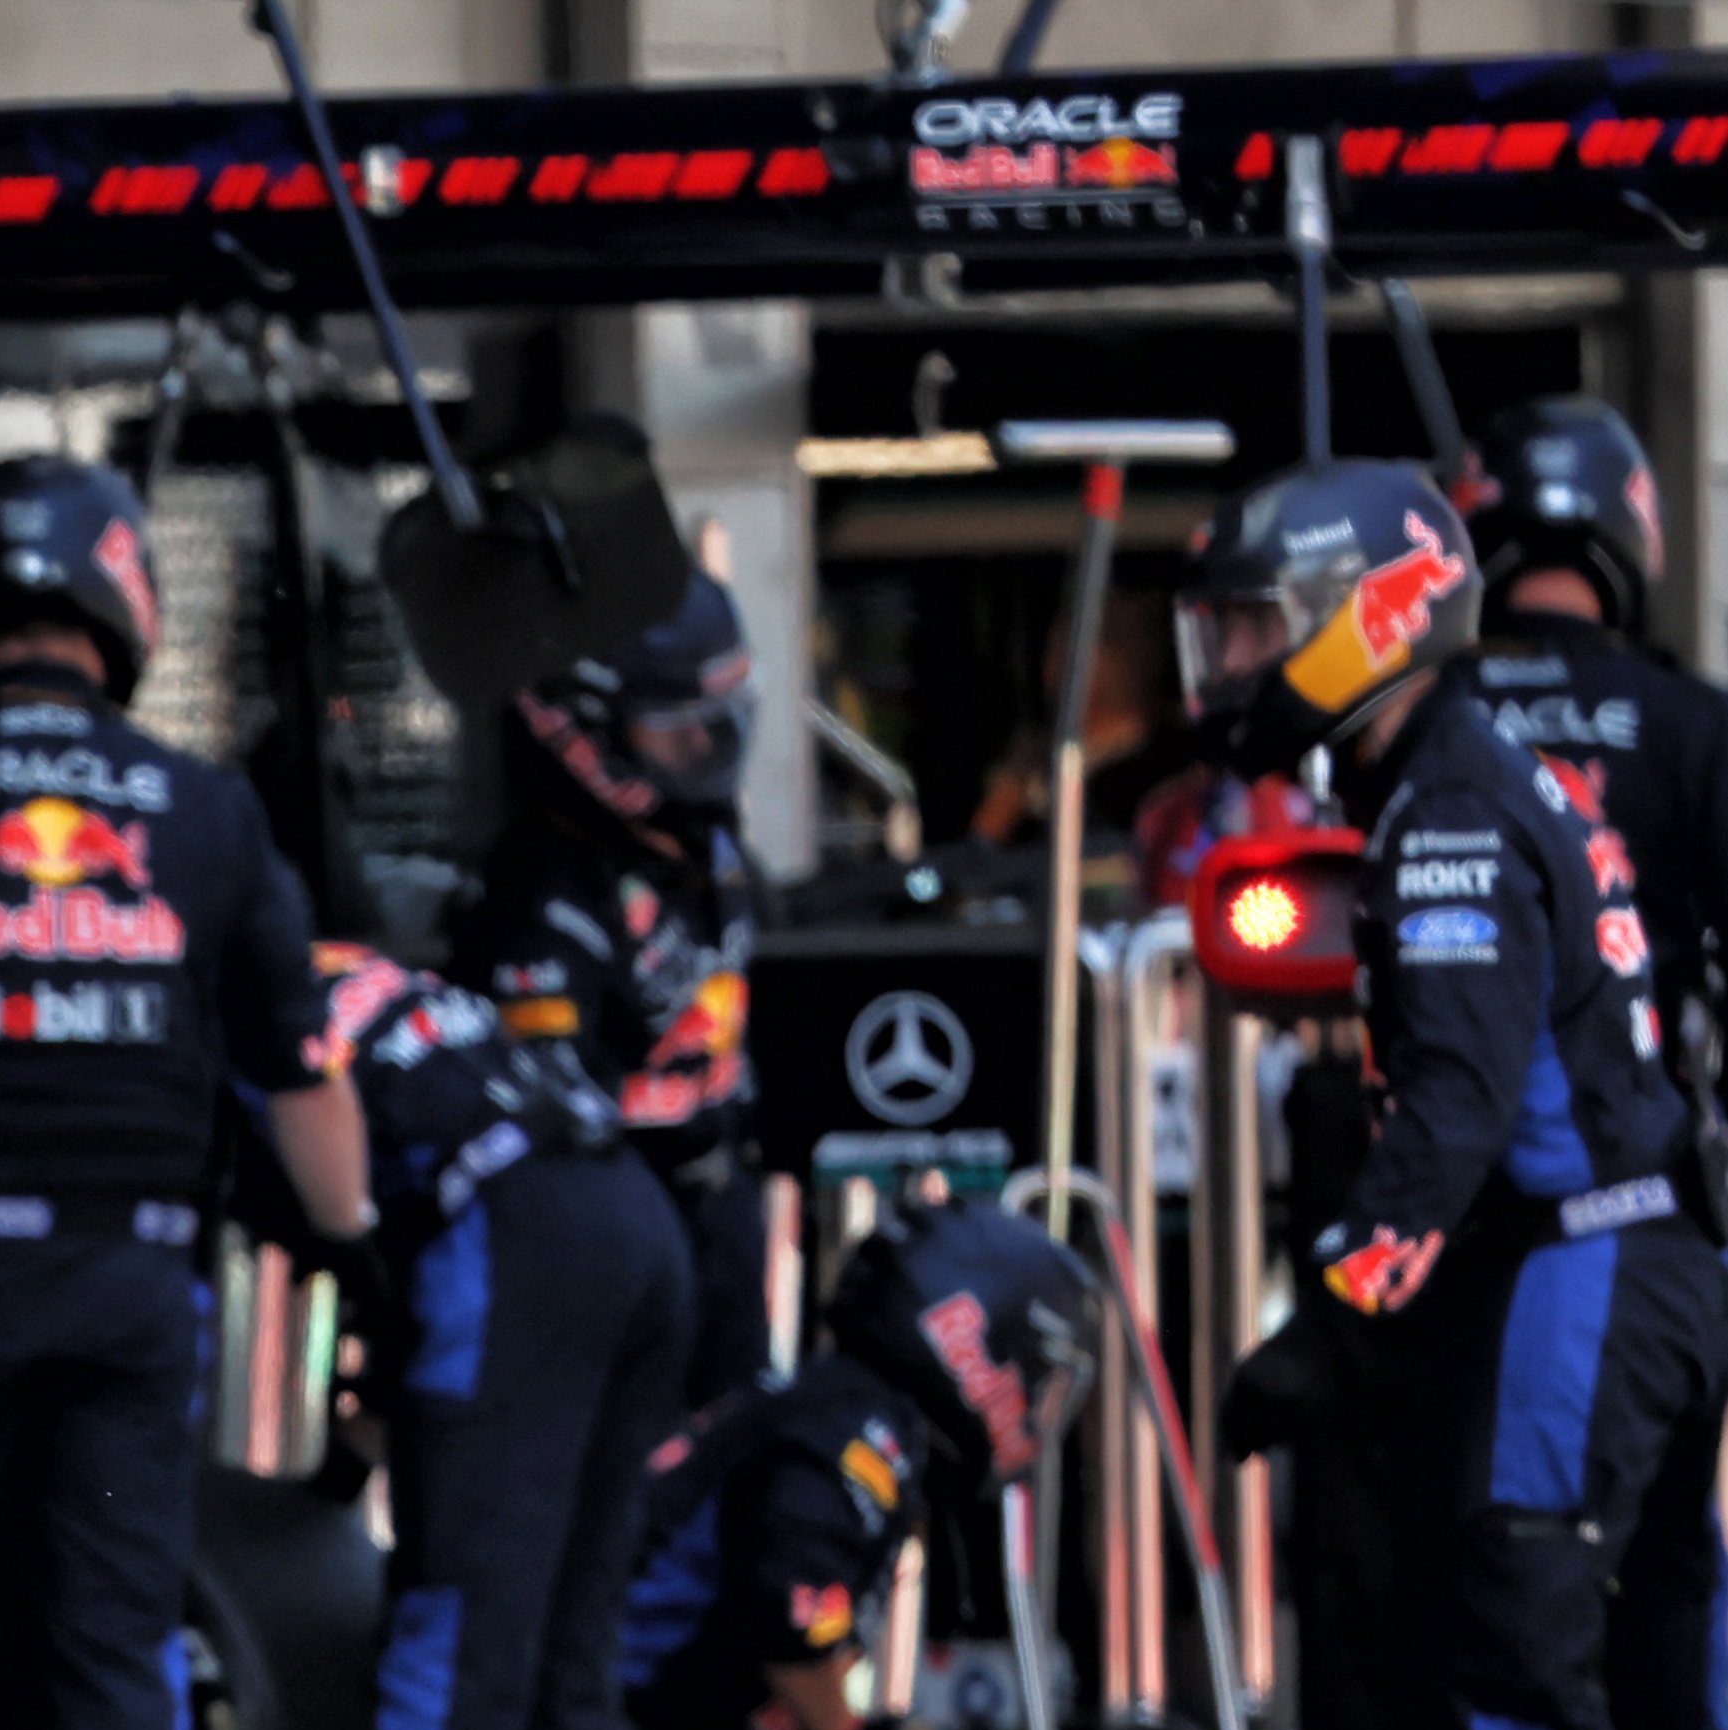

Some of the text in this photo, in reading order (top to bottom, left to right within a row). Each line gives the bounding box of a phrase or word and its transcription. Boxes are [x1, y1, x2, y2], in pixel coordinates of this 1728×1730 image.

[913, 93, 1181, 146] ORACLE
[910, 147, 985, 190] Red
[1397, 859, 1498, 899] ROKT
[59, 888, 185, 957] Bull
